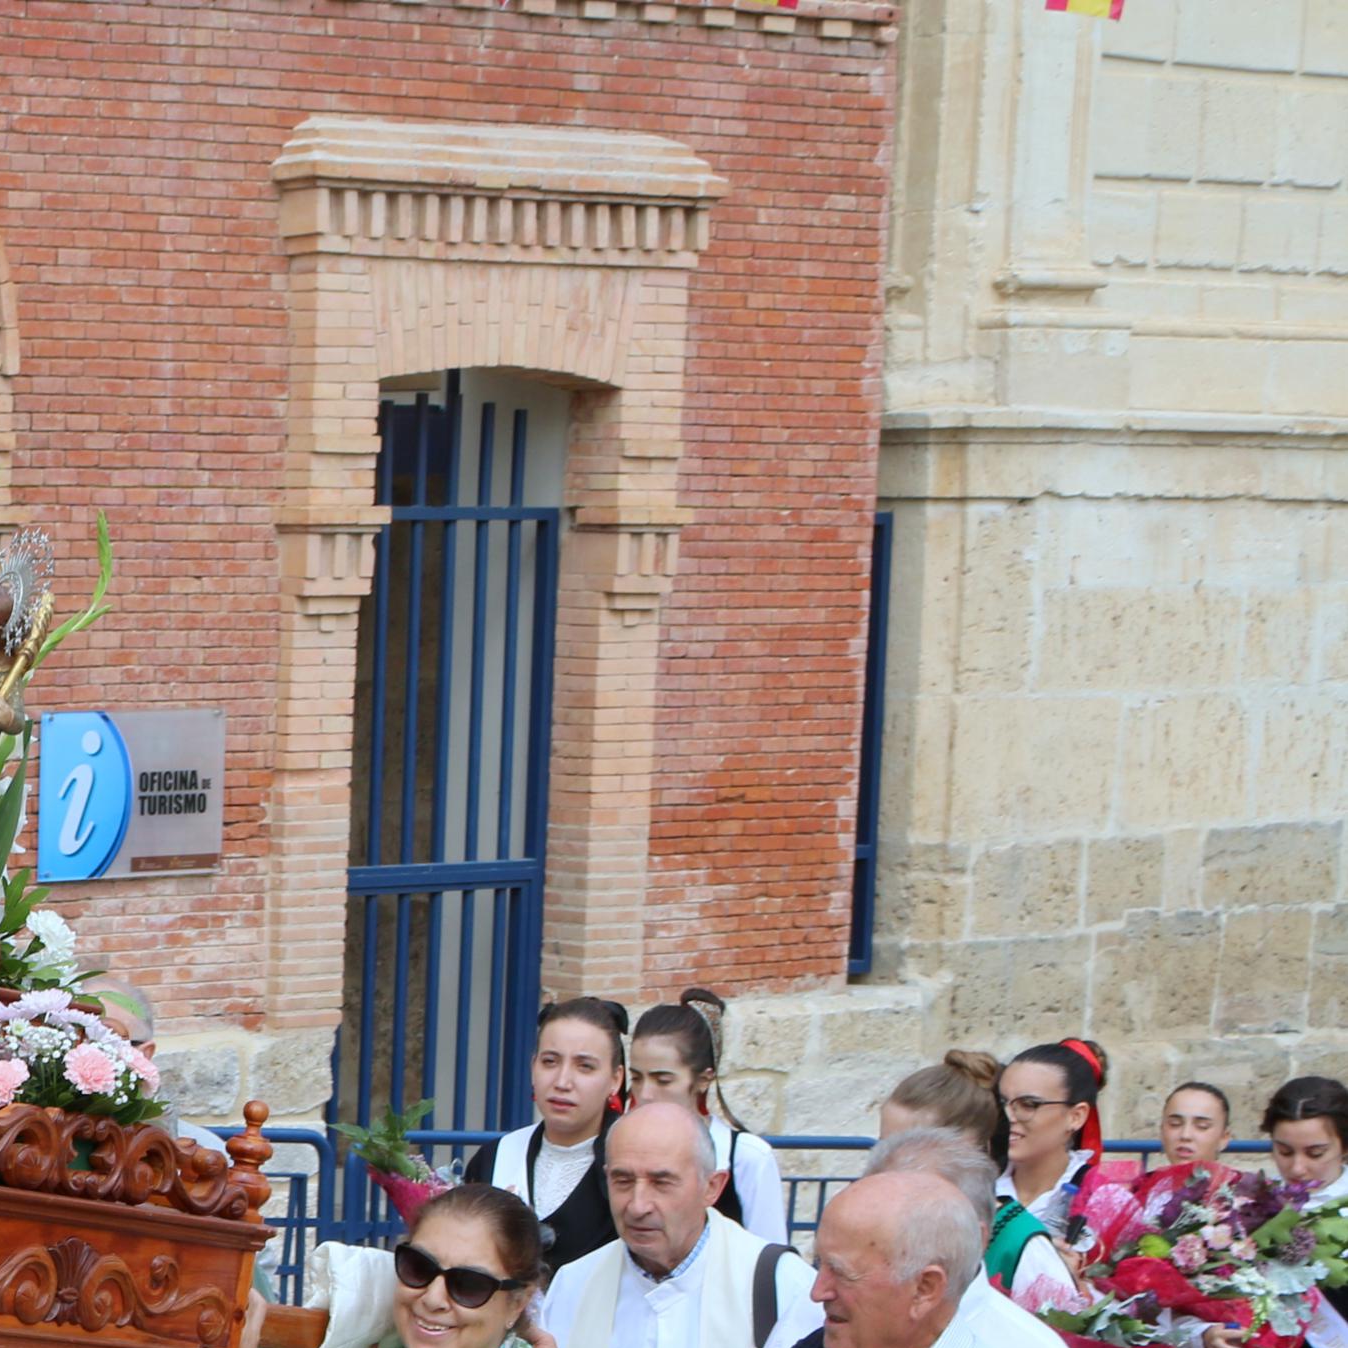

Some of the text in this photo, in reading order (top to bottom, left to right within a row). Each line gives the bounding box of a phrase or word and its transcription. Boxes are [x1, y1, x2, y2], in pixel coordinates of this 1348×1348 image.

[139, 770, 211, 793] OFICINA DE
[137, 793, 207, 817] TURISMO
